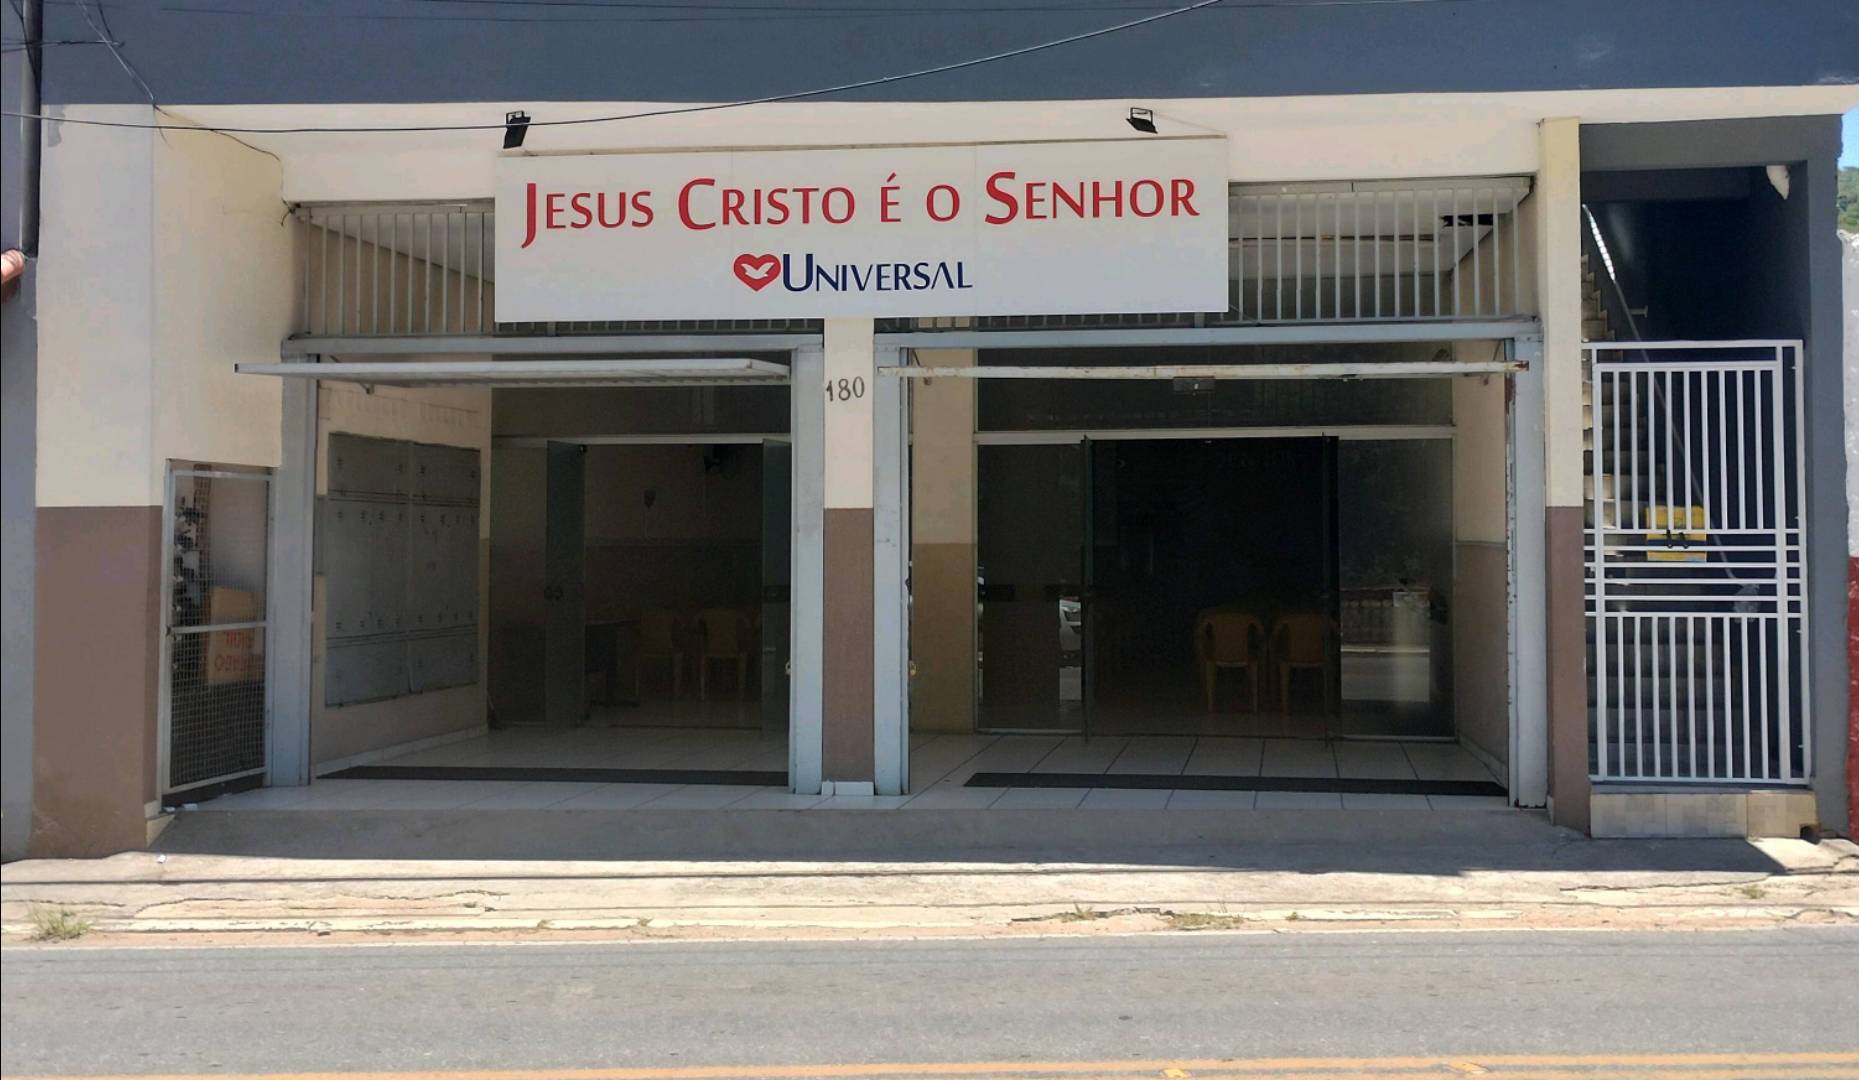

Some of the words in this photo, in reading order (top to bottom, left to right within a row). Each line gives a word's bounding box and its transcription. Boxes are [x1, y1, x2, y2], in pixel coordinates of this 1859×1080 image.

[521, 182, 654, 248] JESUS
[677, 177, 856, 232] CRISTO
[879, 171, 902, 224] É
[925, 183, 961, 223] O
[984, 170, 1201, 225] SENHOR
[782, 253, 973, 292] UNIVERSAL
[826, 376, 865, 402] 180
